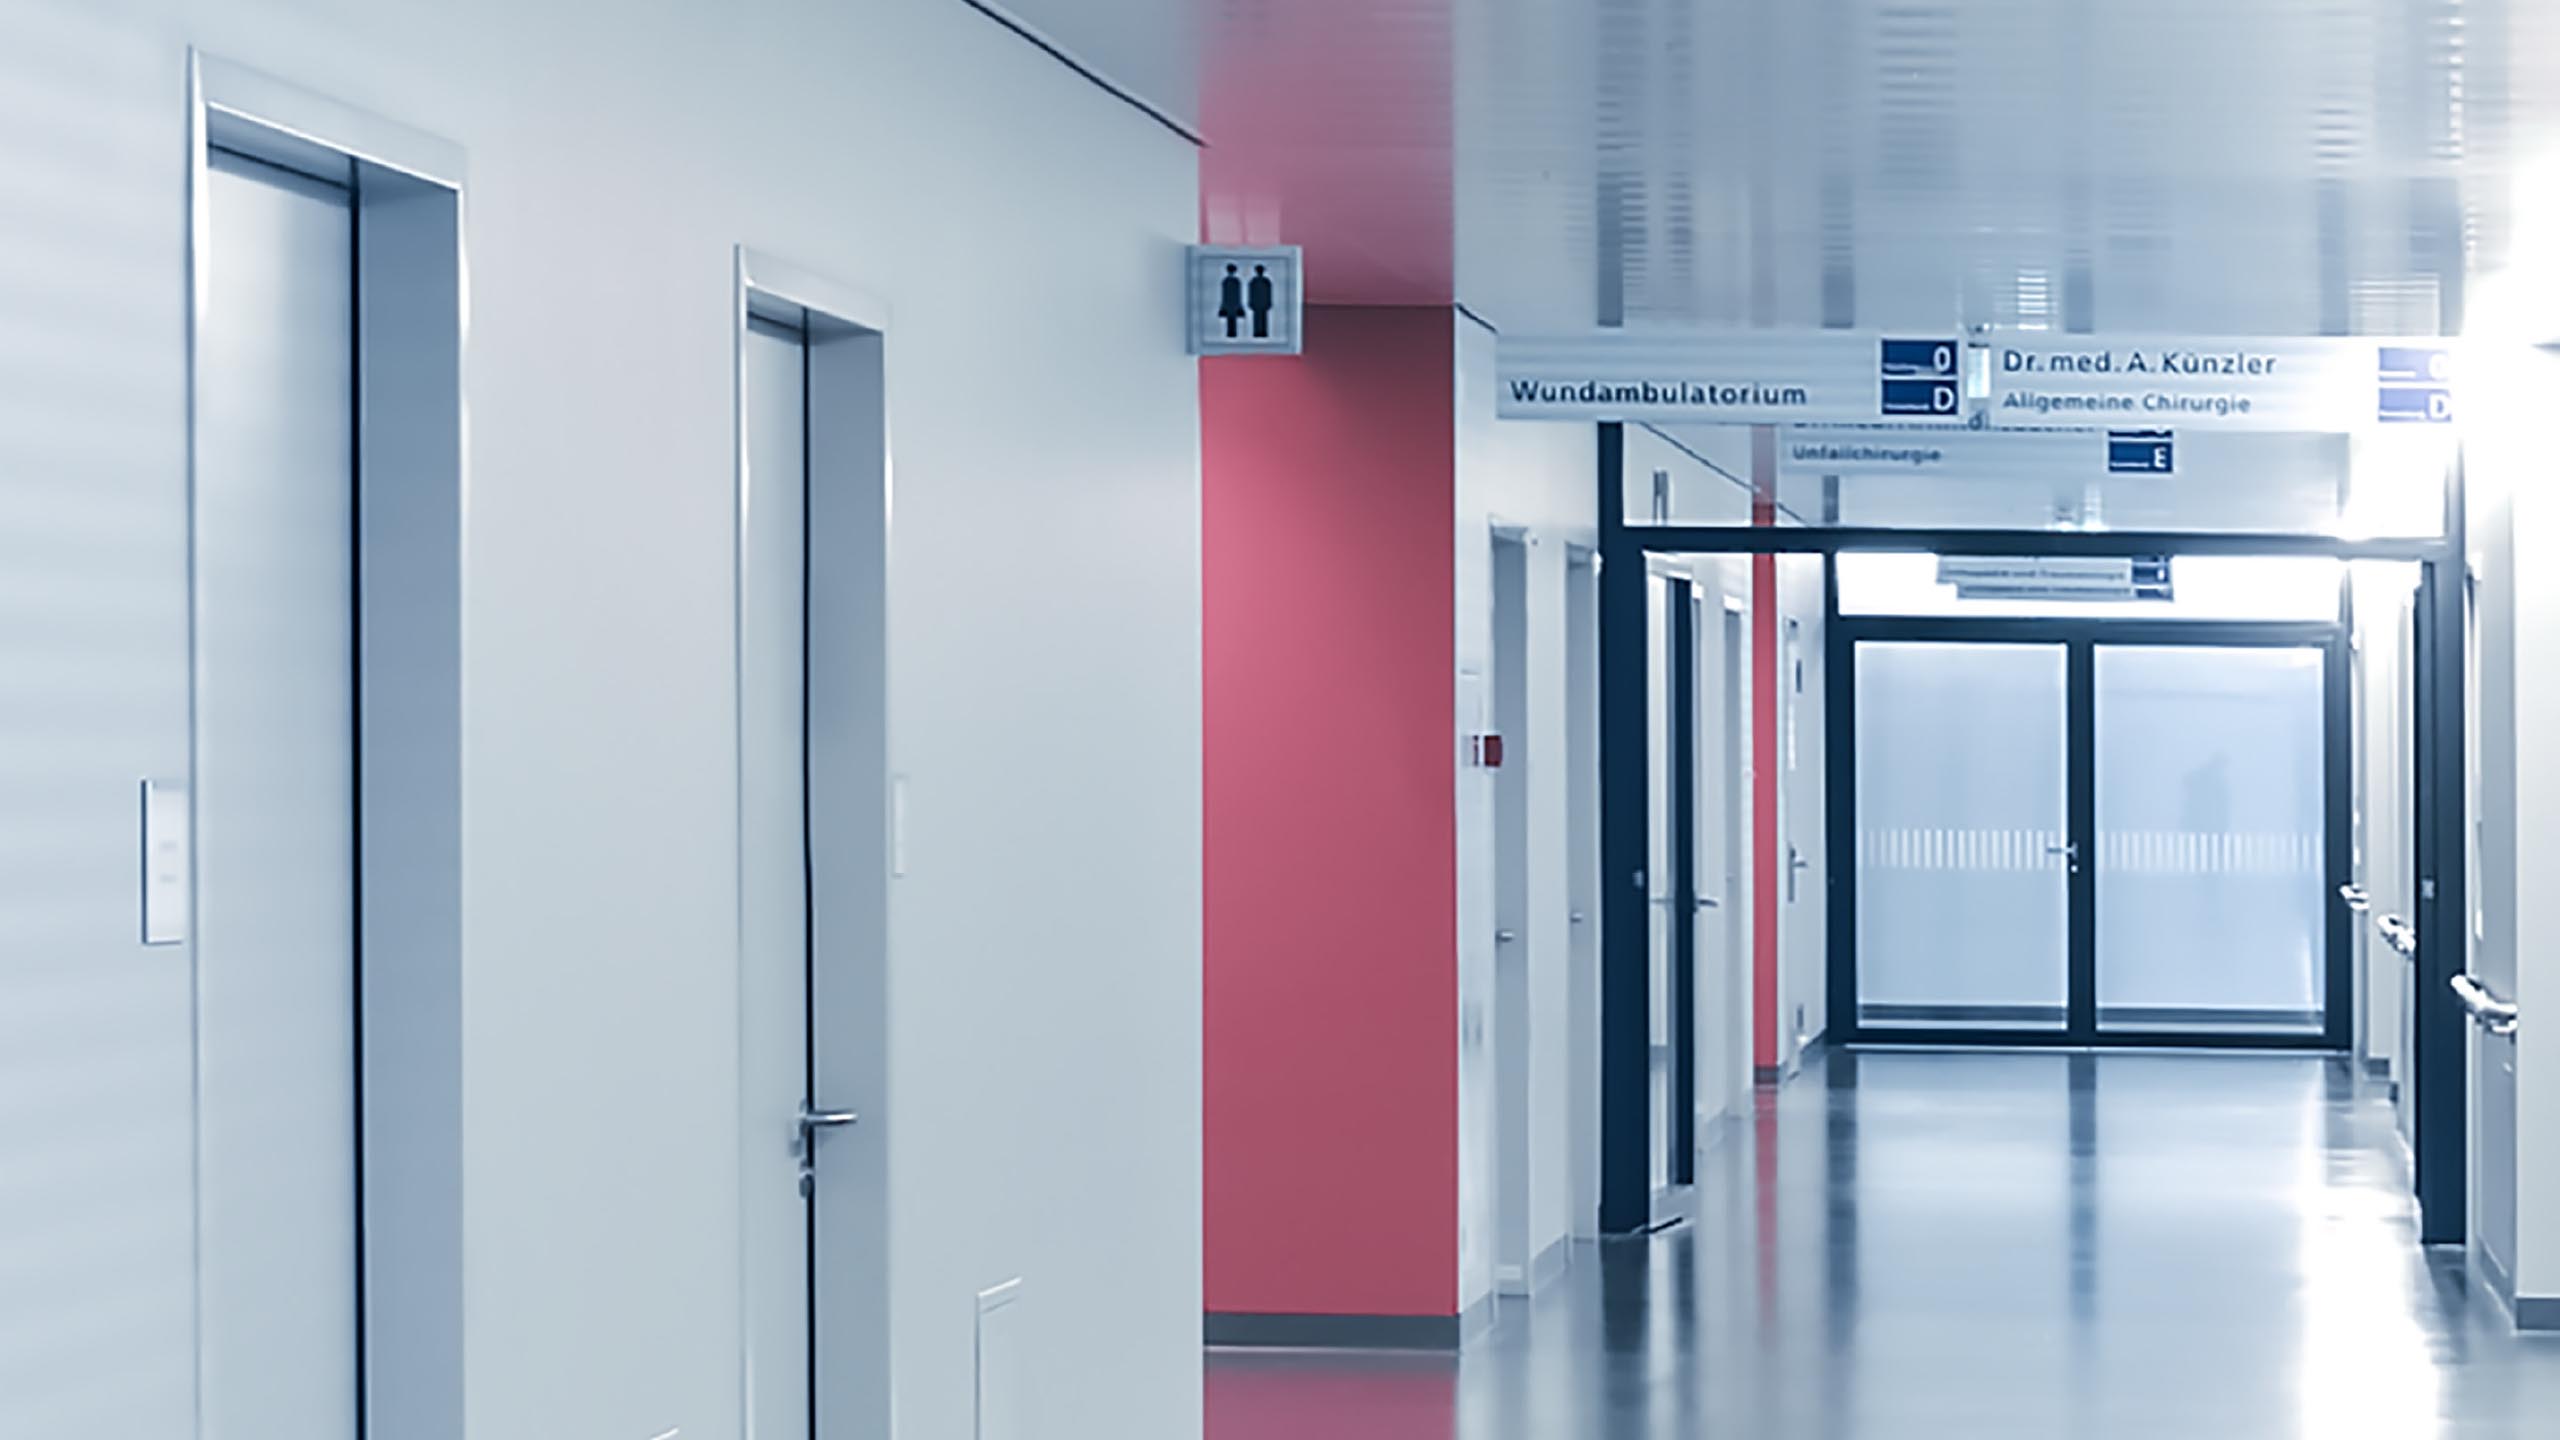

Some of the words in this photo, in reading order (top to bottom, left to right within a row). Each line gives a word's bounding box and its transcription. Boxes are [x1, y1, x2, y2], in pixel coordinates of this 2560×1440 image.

[2003, 349, 2045, 373] Dr.
[2050, 351, 2122, 373] med.
[2127, 351, 2155, 373] A.
[2162, 351, 2276, 374] Künzler
[1510, 379, 1807, 406] Wundambulatorium
[1933, 386, 1955, 412] D
[2003, 391, 2134, 415] Allgemeine
[2142, 393, 2251, 416] Chirurgie
[2153, 446, 2167, 469] E
